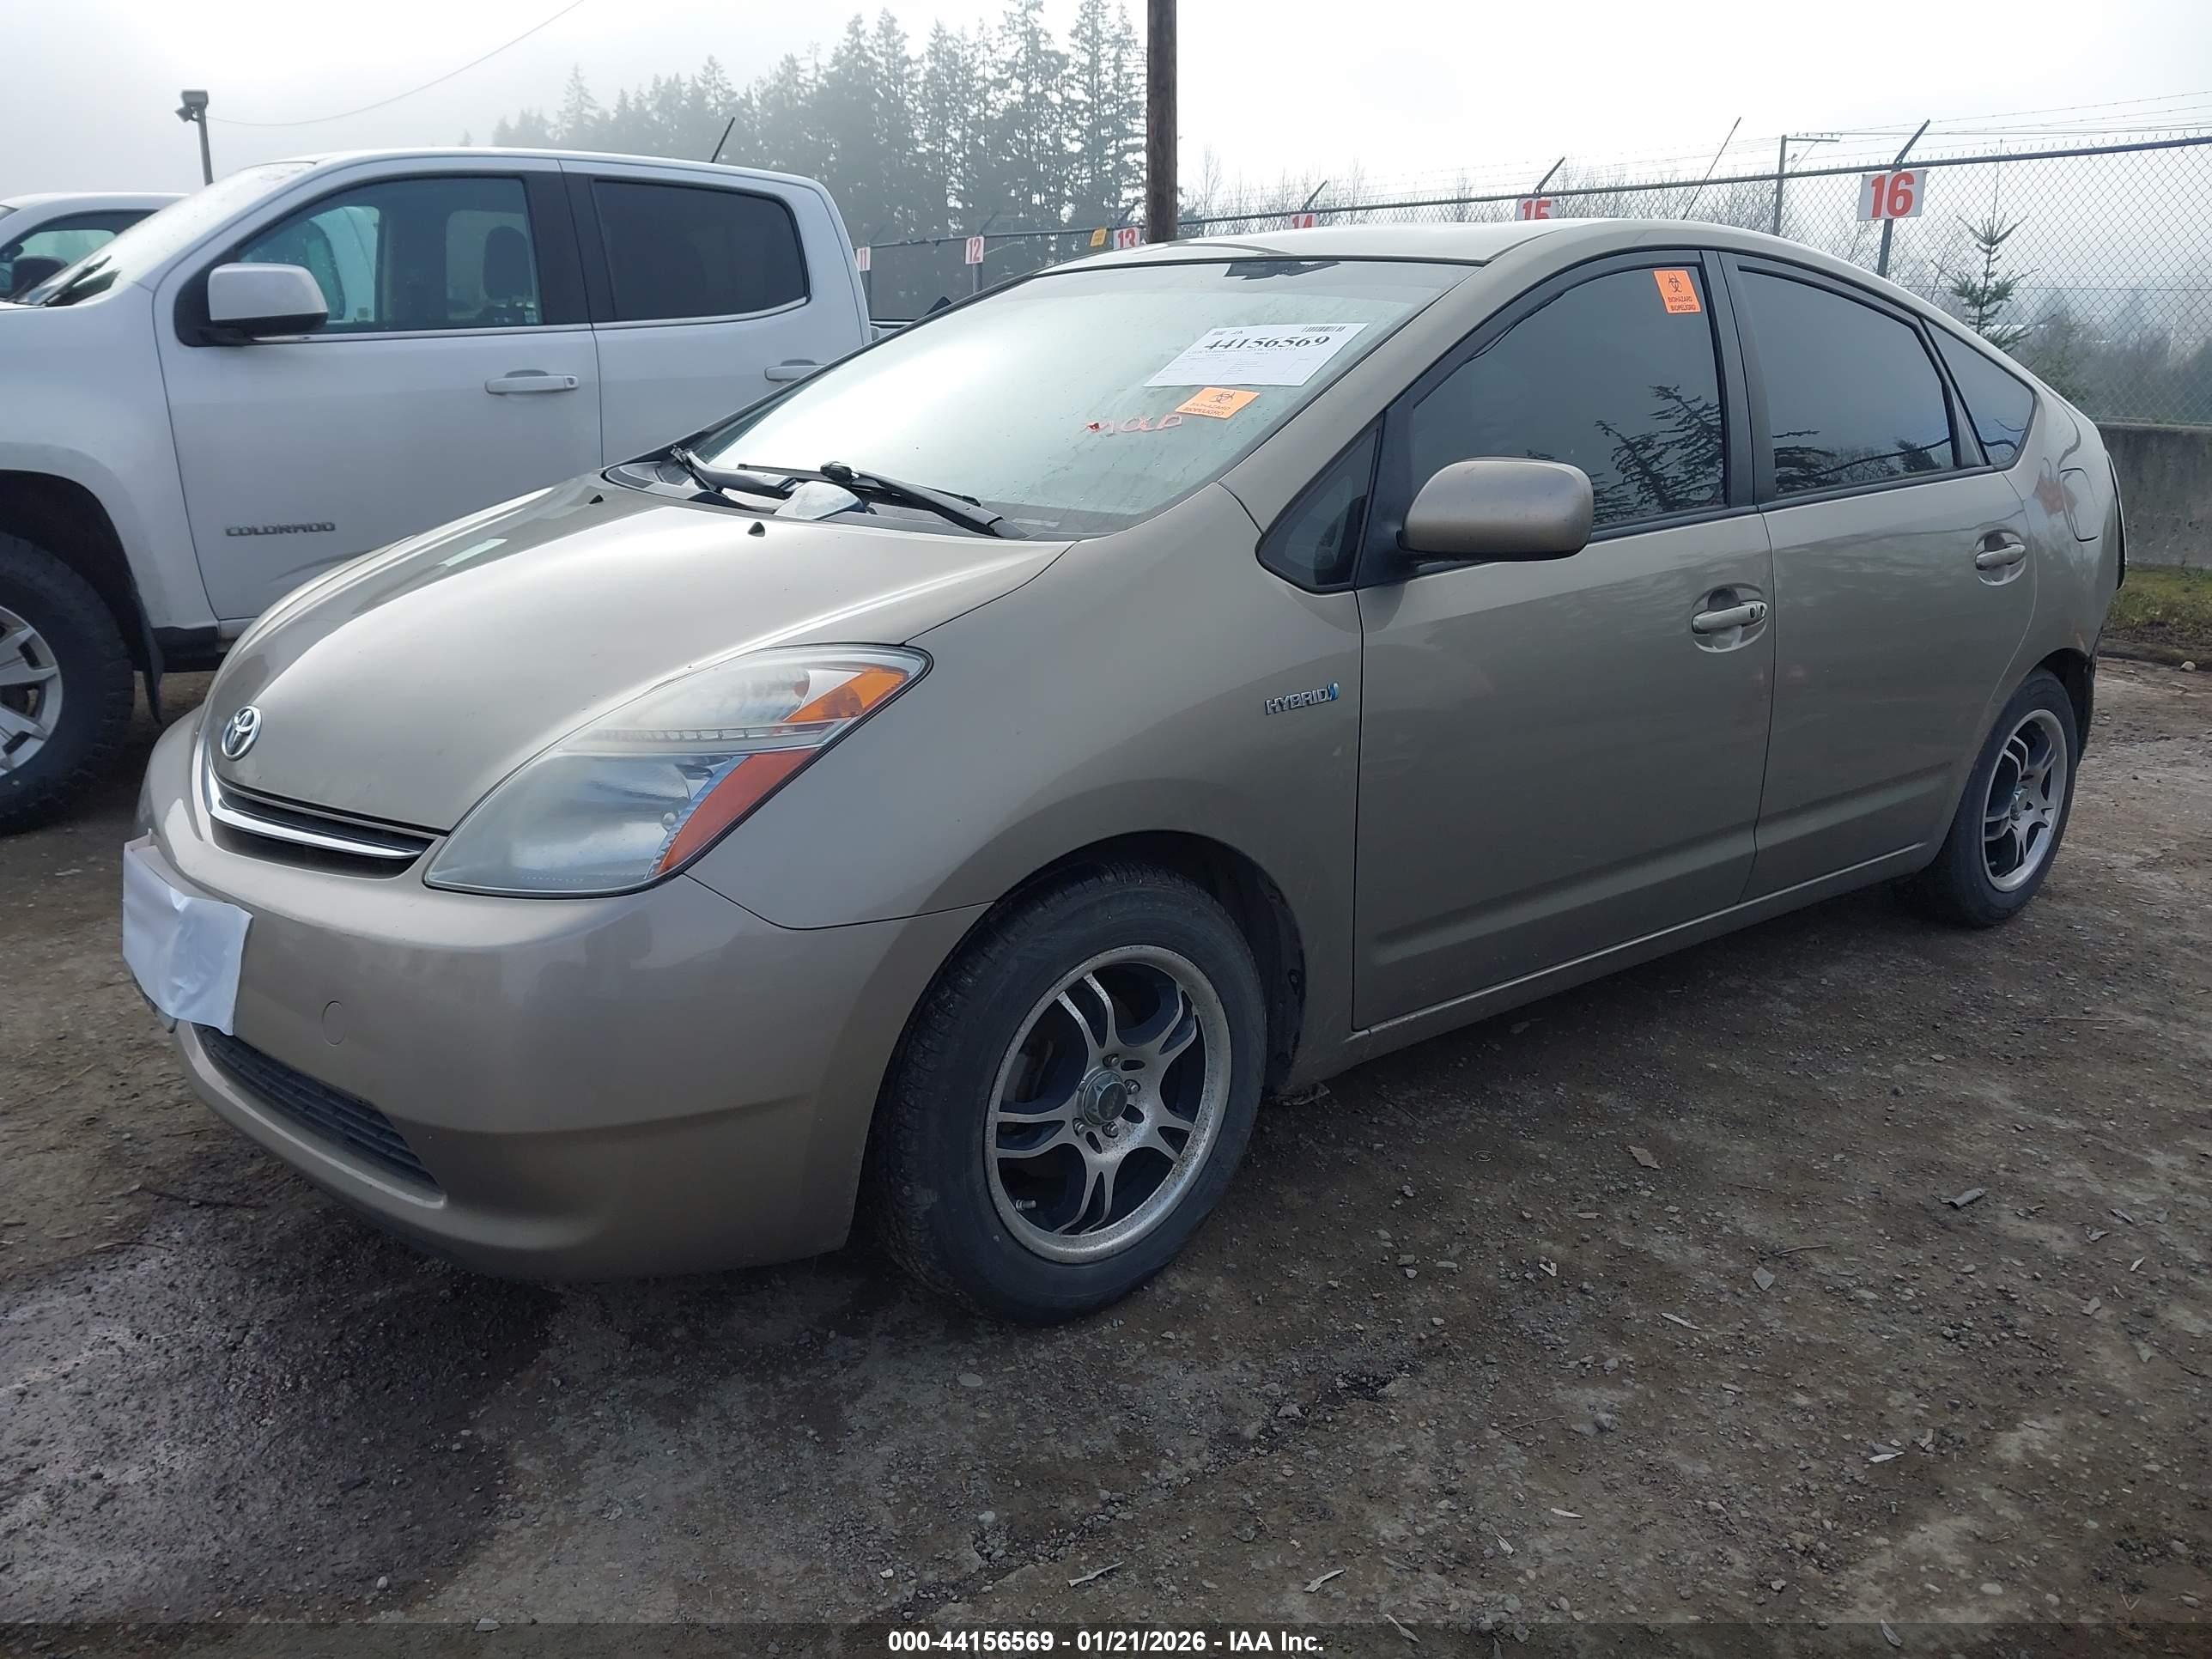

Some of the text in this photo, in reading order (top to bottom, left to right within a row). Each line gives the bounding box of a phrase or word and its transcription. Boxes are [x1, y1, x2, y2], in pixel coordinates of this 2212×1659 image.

[1871, 172, 1914, 218] 16
[860, 249, 867, 270] 11
[969, 238, 981, 263] 12
[1204, 335, 1330, 349] 44156569
[226, 521, 336, 537] COLORADO
[1265, 688, 1329, 715] HYBRID
